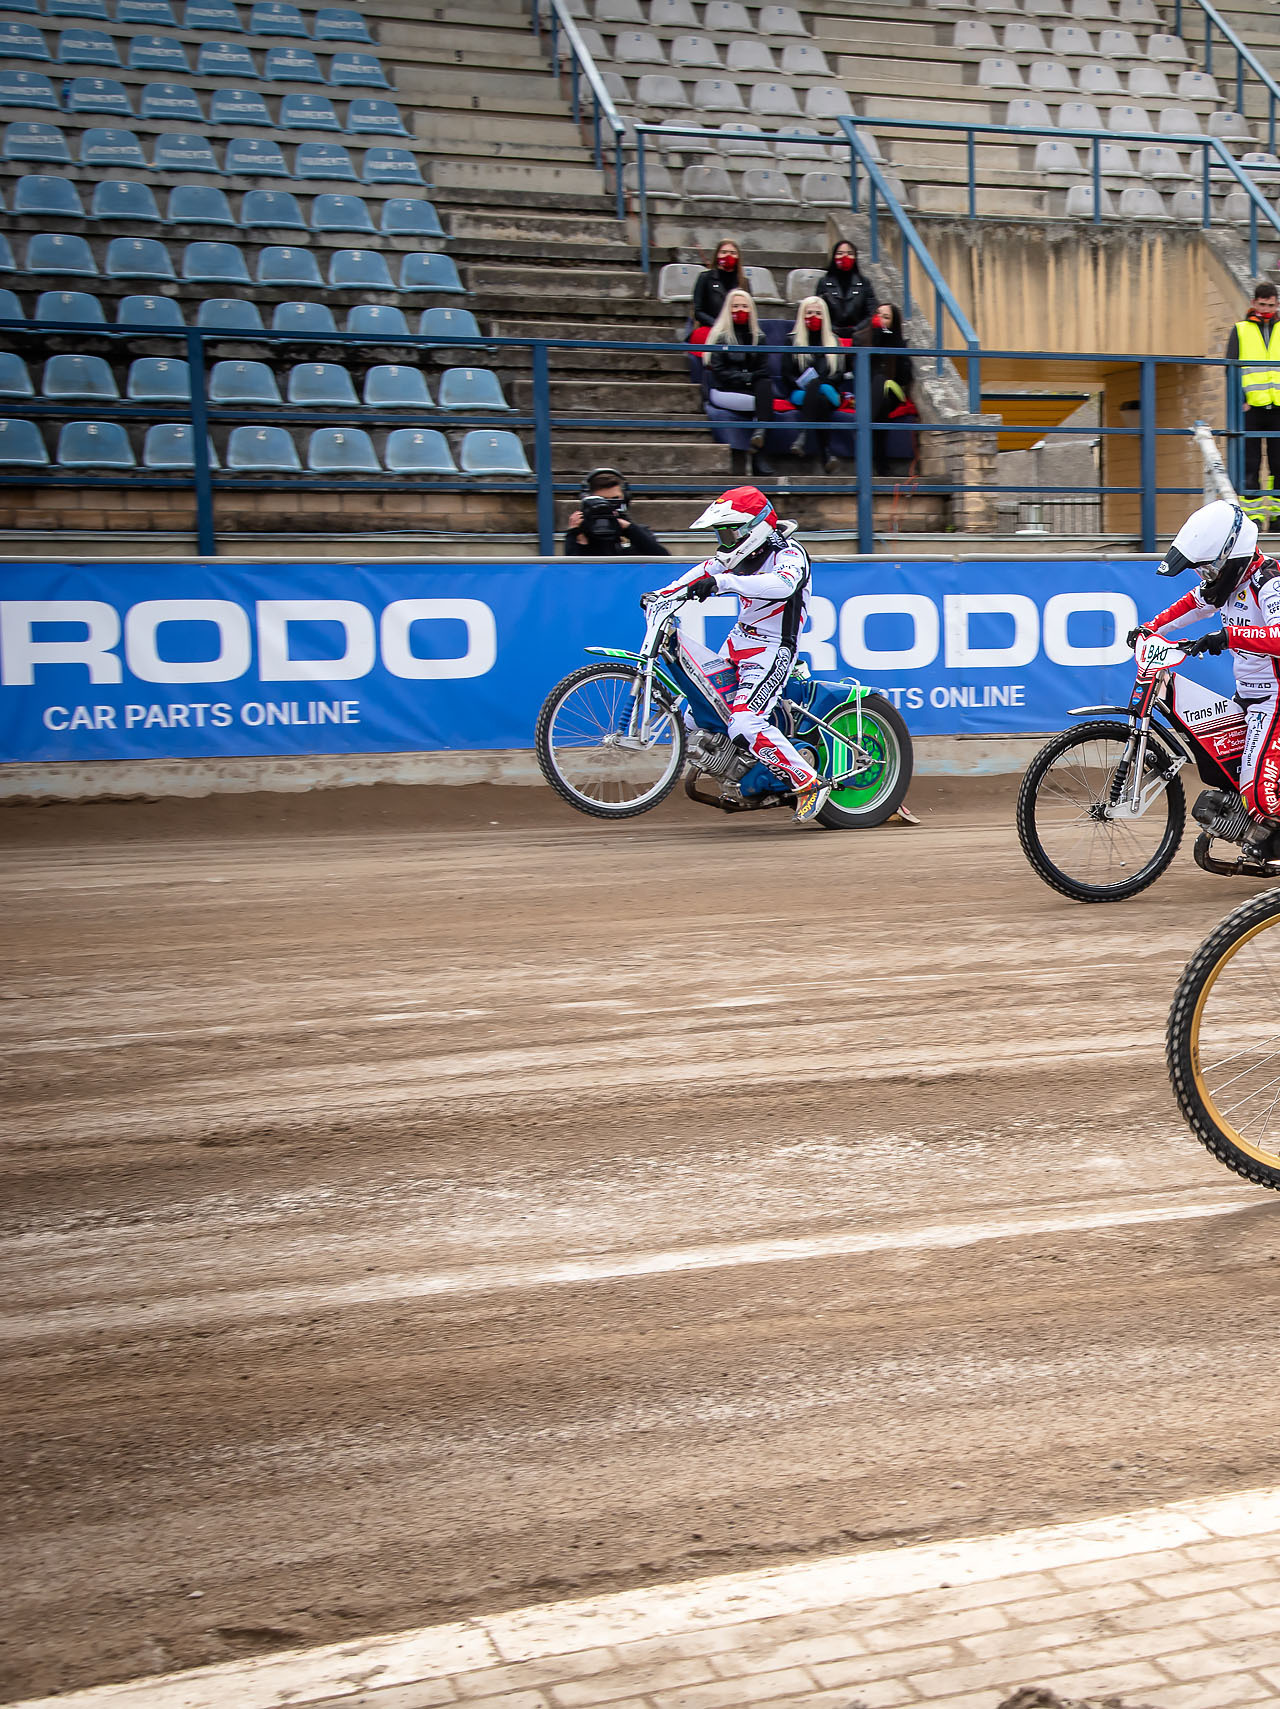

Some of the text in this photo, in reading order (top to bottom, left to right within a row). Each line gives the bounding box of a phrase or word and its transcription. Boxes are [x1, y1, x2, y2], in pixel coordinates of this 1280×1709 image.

[1232, 626, 1267, 639] Trans
[930, 685, 1026, 709] ONLINE
[42, 700, 361, 731] CAR PARTS ONLINE
[1183, 700, 1229, 724] Trans MF
